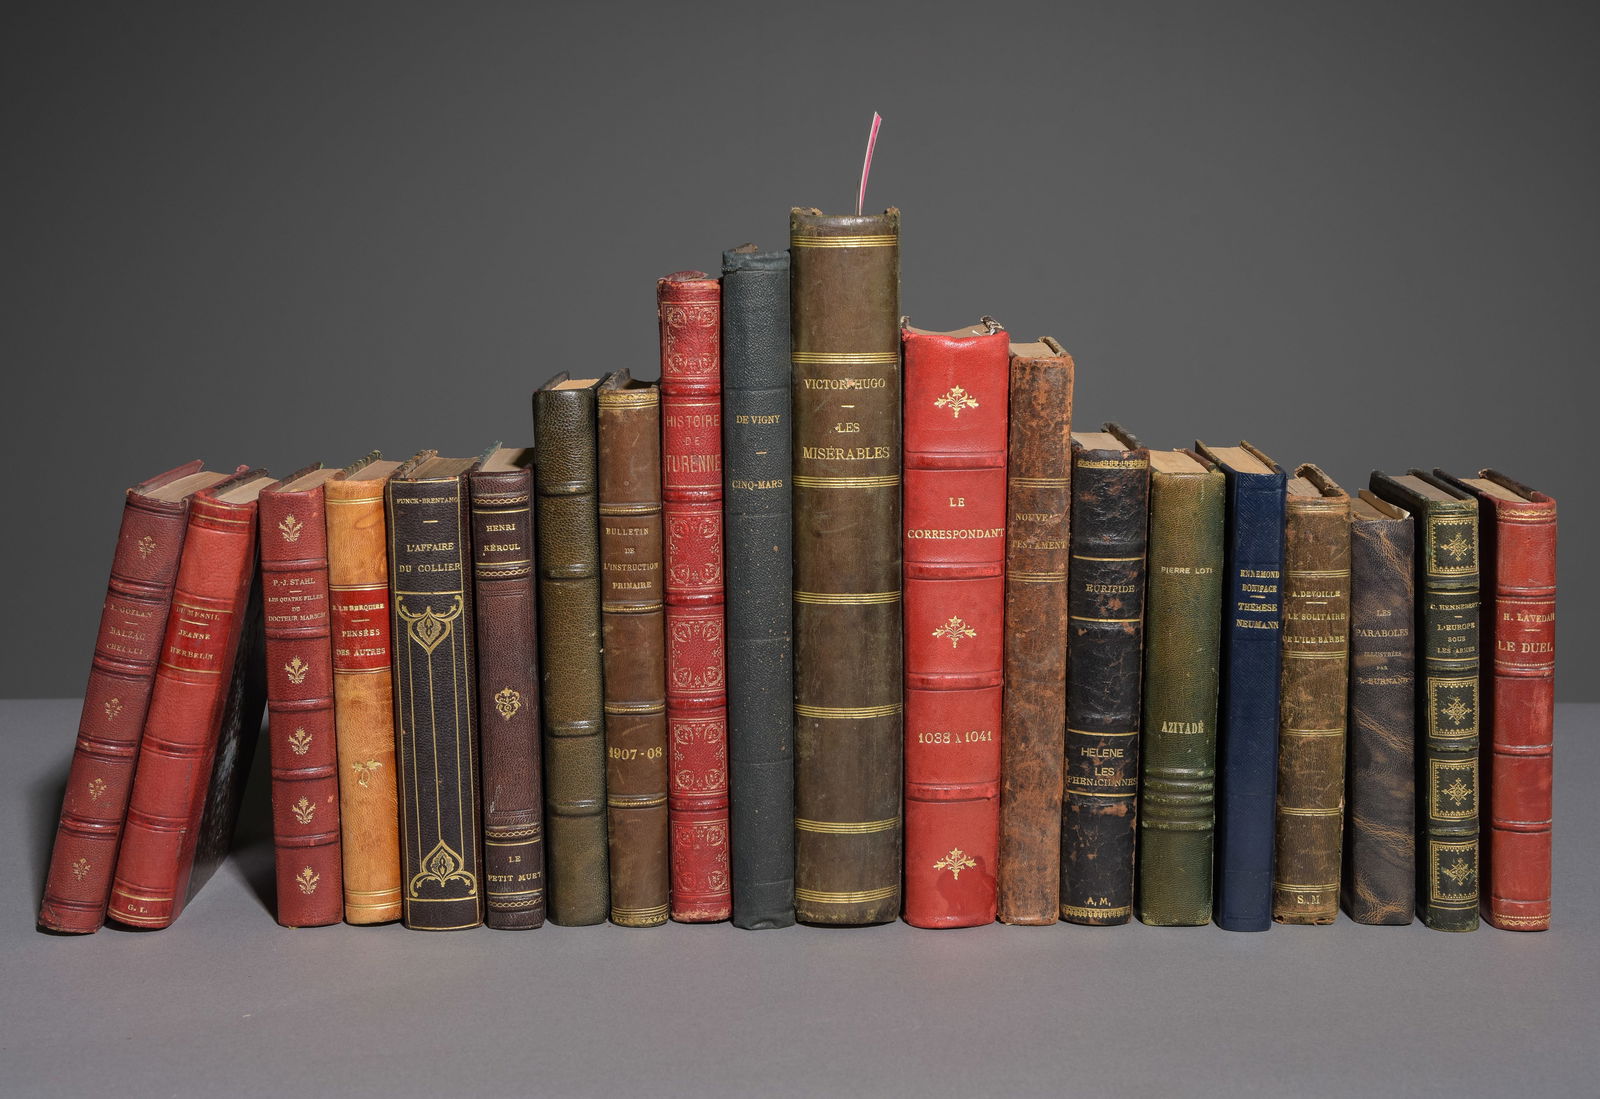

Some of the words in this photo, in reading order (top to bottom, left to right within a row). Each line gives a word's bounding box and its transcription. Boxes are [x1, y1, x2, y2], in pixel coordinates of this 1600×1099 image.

[804, 379, 848, 390] VICTOR
[854, 378, 886, 390] HUGO
[666, 414, 720, 428] HISTOIRE
[736, 415, 749, 424] DE
[751, 415, 781, 424] VIGNY
[837, 422, 860, 433] LES
[683, 437, 701, 446] DE
[803, 445, 890, 460] MISÉRABLES
[665, 454, 720, 473] TURENNE
[732, 480, 783, 490] CINQ-MARS
[950, 497, 965, 507] LE
[486, 523, 516, 532] HENRI
[605, 527, 649, 536] BULLETIN
[907, 528, 1005, 539] CORRESPONDANT
[407, 542, 454, 553] L'AFFAIRE
[483, 543, 521, 552] KÉROUL
[399, 564, 412, 573] DU
[418, 562, 460, 572] COLLIER
[603, 562, 659, 571] L'INSTRUCTION
[1161, 566, 1191, 574] PIERRE
[290, 577, 315, 586] STAHL
[612, 581, 652, 590] PRIMAIRE
[1085, 583, 1135, 593] EURIPIDE
[268, 614, 298, 622] DOCTEUR
[1376, 609, 1391, 617] LES
[1503, 612, 1514, 621] H.
[1236, 619, 1279, 629] NEUMANN
[178, 628, 211, 640] JEANNE
[341, 628, 381, 637] PENSÉES
[1317, 635, 1345, 644] BARBE
[1498, 640, 1516, 652] LE
[1521, 642, 1553, 653] DUEL
[354, 647, 386, 657] AUTRES
[1161, 720, 1204, 734] AZIYADÉ
[918, 732, 951, 744] 1038
[965, 730, 993, 743] 1041
[1081, 747, 1124, 758] HELENE
[1094, 767, 1115, 777] LES
[508, 855, 521, 863] LE
[487, 873, 514, 882] PETIT
